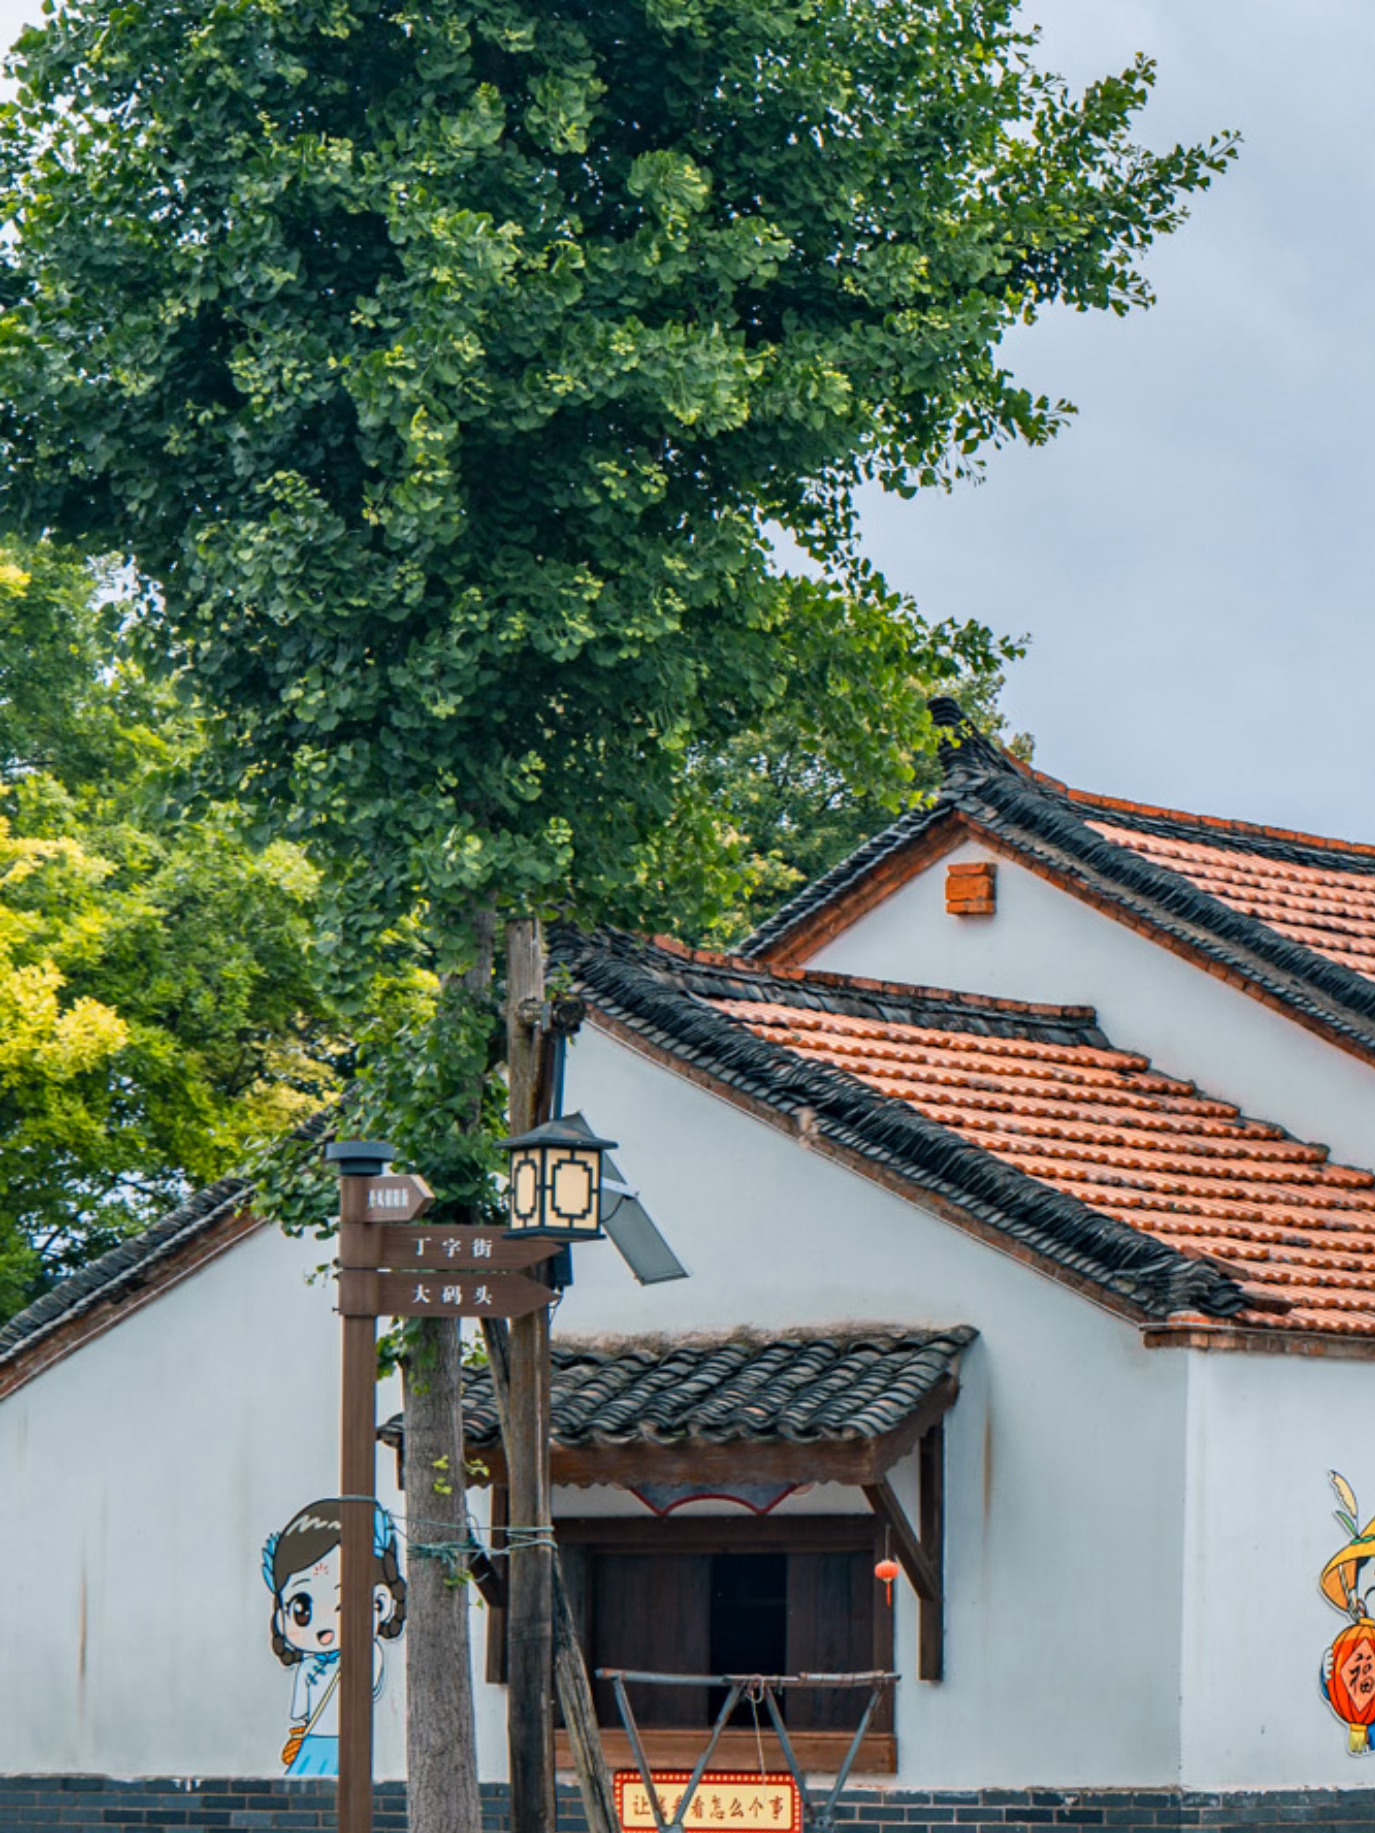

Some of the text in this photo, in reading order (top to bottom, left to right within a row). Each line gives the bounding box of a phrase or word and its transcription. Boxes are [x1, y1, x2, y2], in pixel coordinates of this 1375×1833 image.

[412, 1237, 493, 1258] 丁字街
[412, 1283, 493, 1305] 大码头
